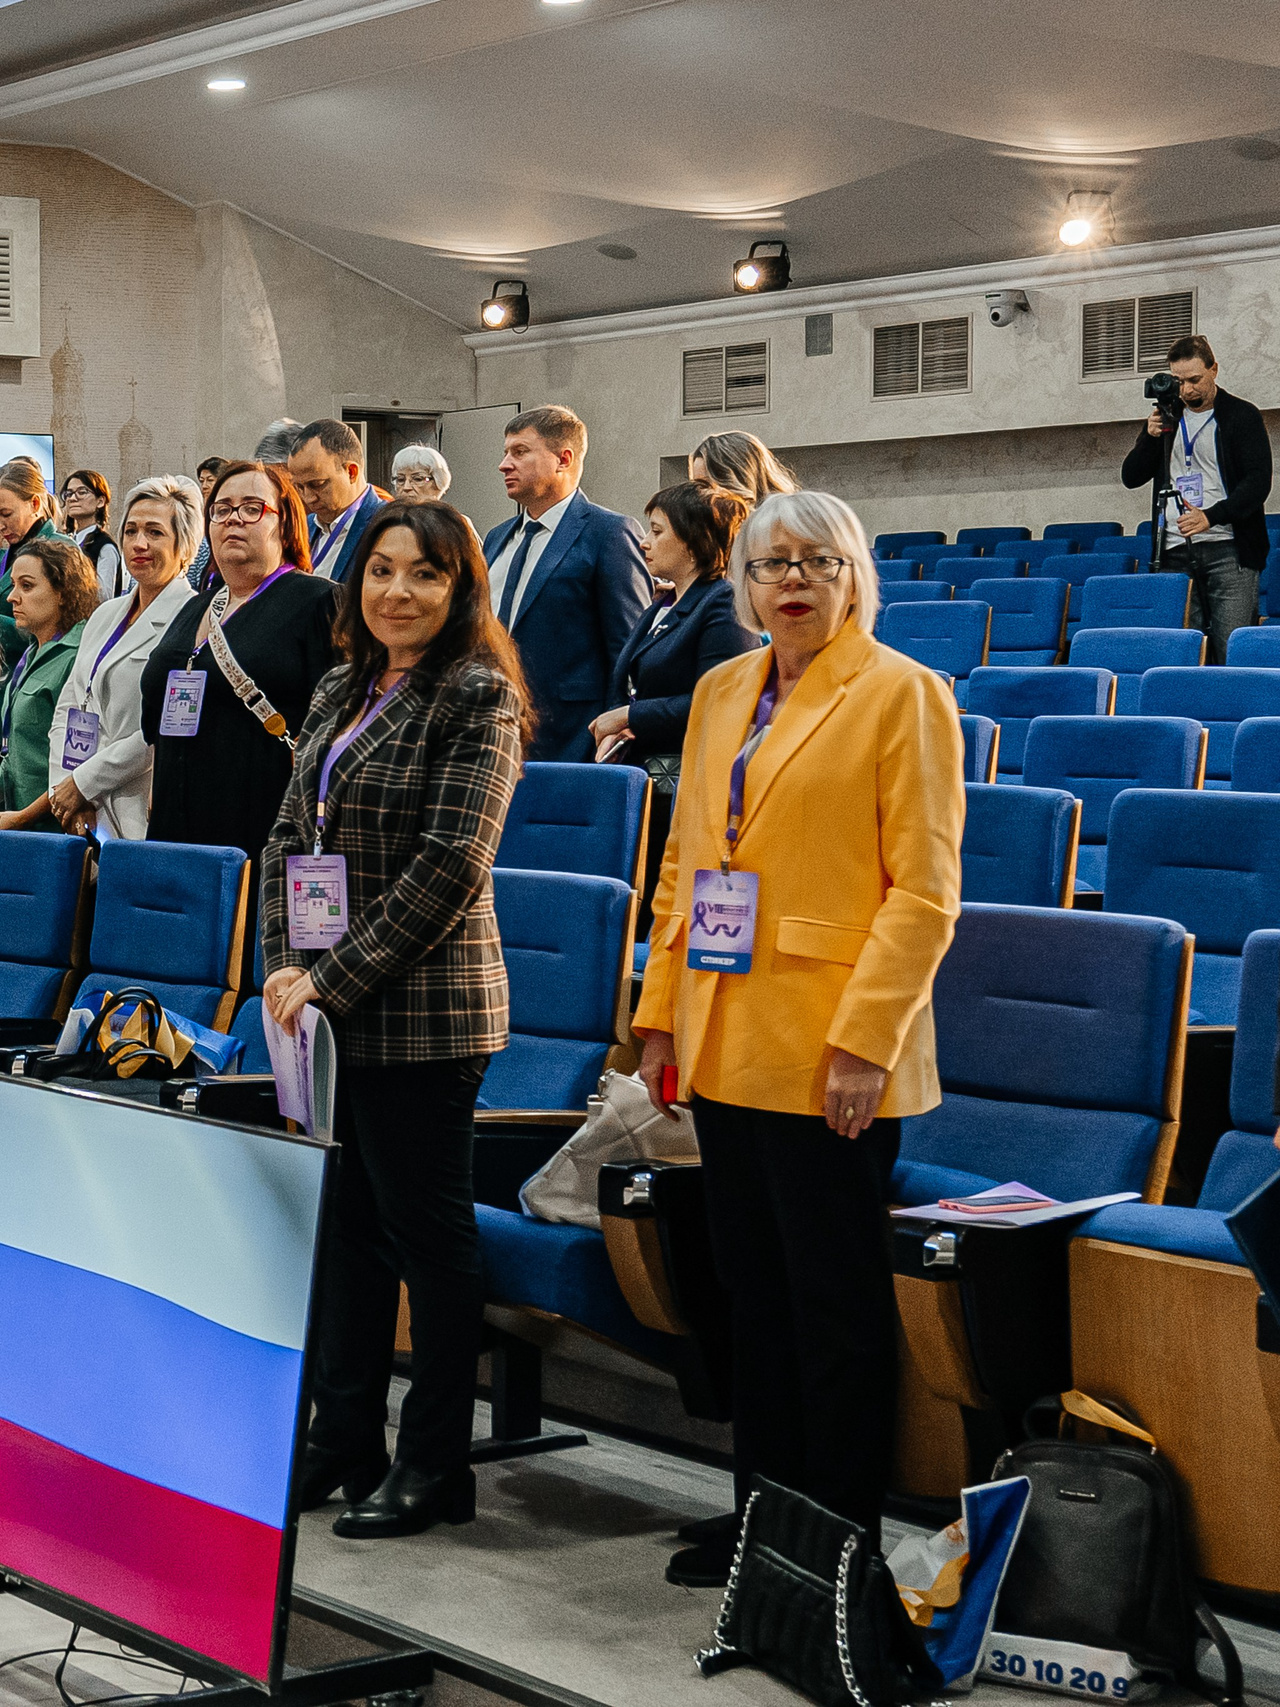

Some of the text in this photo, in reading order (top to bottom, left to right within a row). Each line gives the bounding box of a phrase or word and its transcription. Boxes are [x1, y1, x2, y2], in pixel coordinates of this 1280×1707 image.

[990, 1650, 1129, 1698] 30 10 20 9
